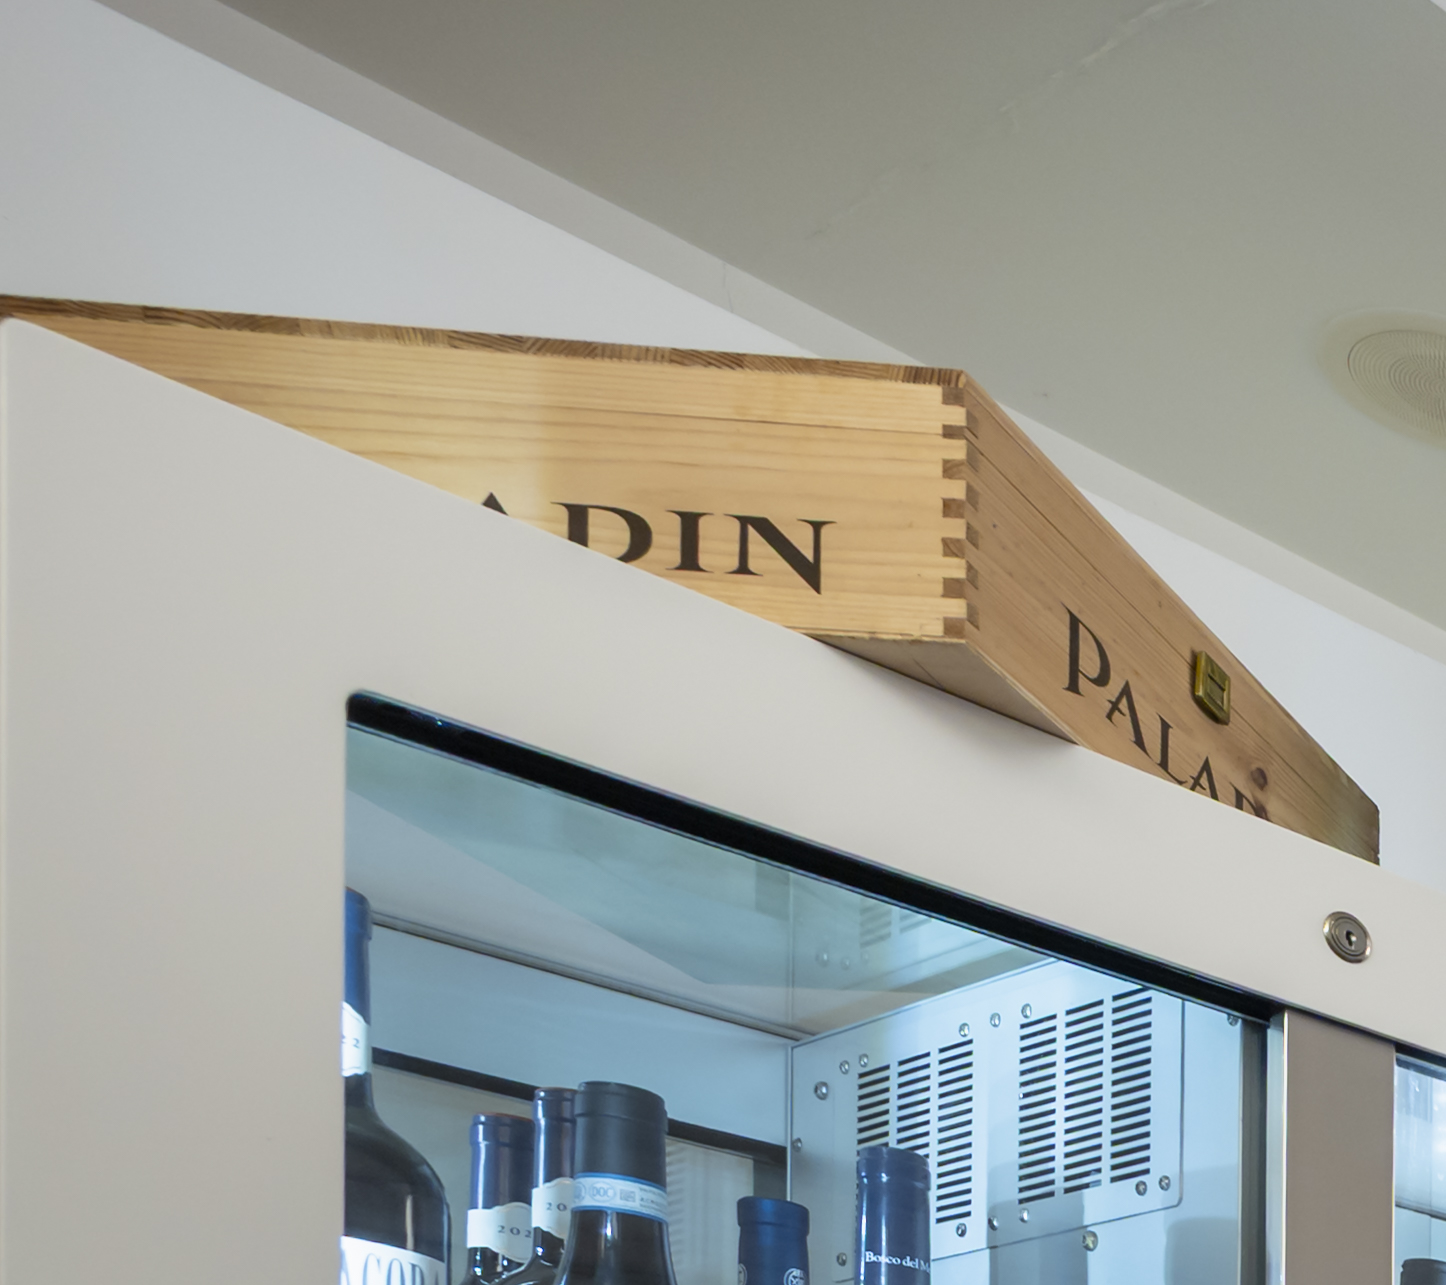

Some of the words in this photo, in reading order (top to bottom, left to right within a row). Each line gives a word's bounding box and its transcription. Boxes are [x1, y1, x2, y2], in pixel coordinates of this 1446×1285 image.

[482, 492, 836, 595] DIN
[546, 1202, 567, 1212] 20
[498, 1225, 532, 1238] 202
[865, 1251, 900, 1266] Bosco
[902, 1256, 919, 1270] del
